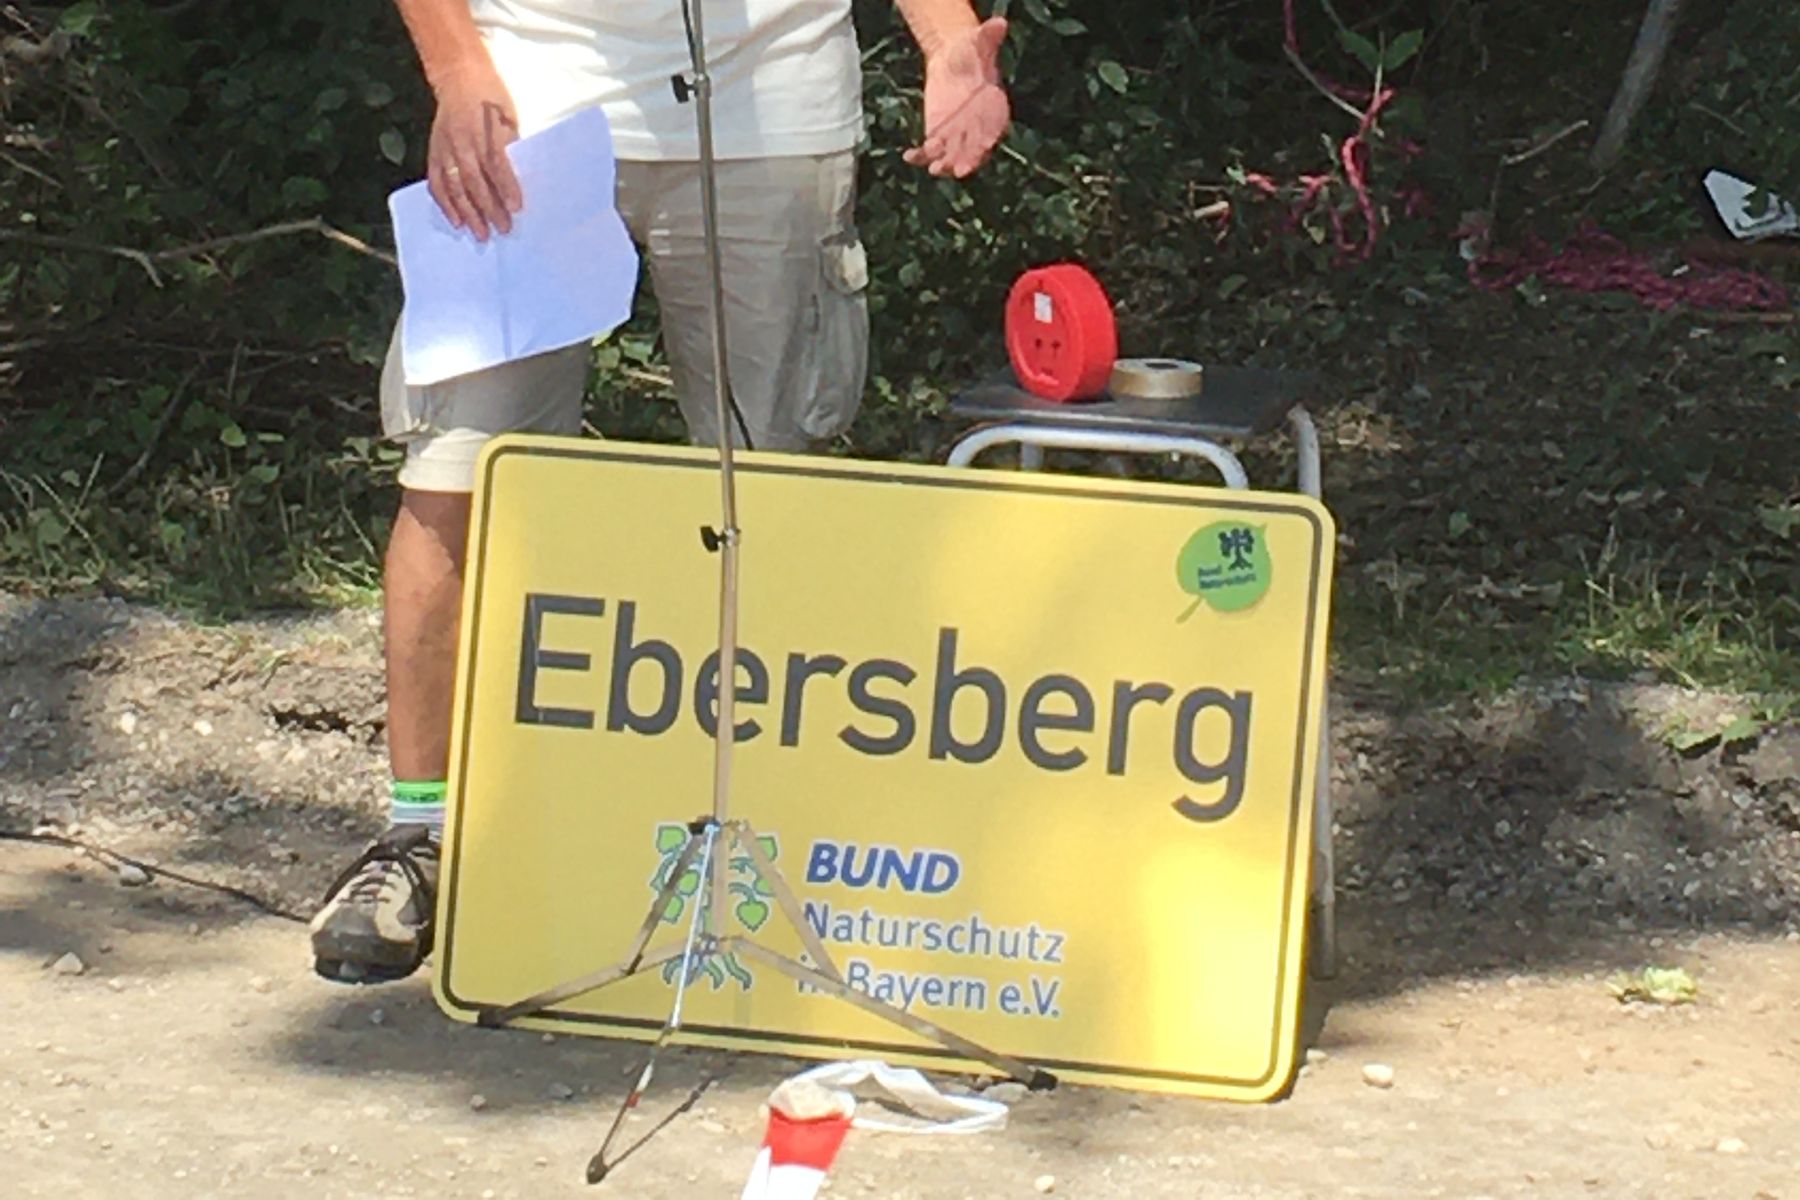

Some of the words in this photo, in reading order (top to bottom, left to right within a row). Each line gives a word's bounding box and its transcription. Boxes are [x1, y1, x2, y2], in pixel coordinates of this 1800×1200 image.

[514, 592, 1254, 823] Ebersberg
[806, 843, 960, 893] BUND
[804, 903, 1065, 963] Naturschutz
[847, 961, 986, 1011] Bayern
[1000, 979, 1060, 1017] e.V.
